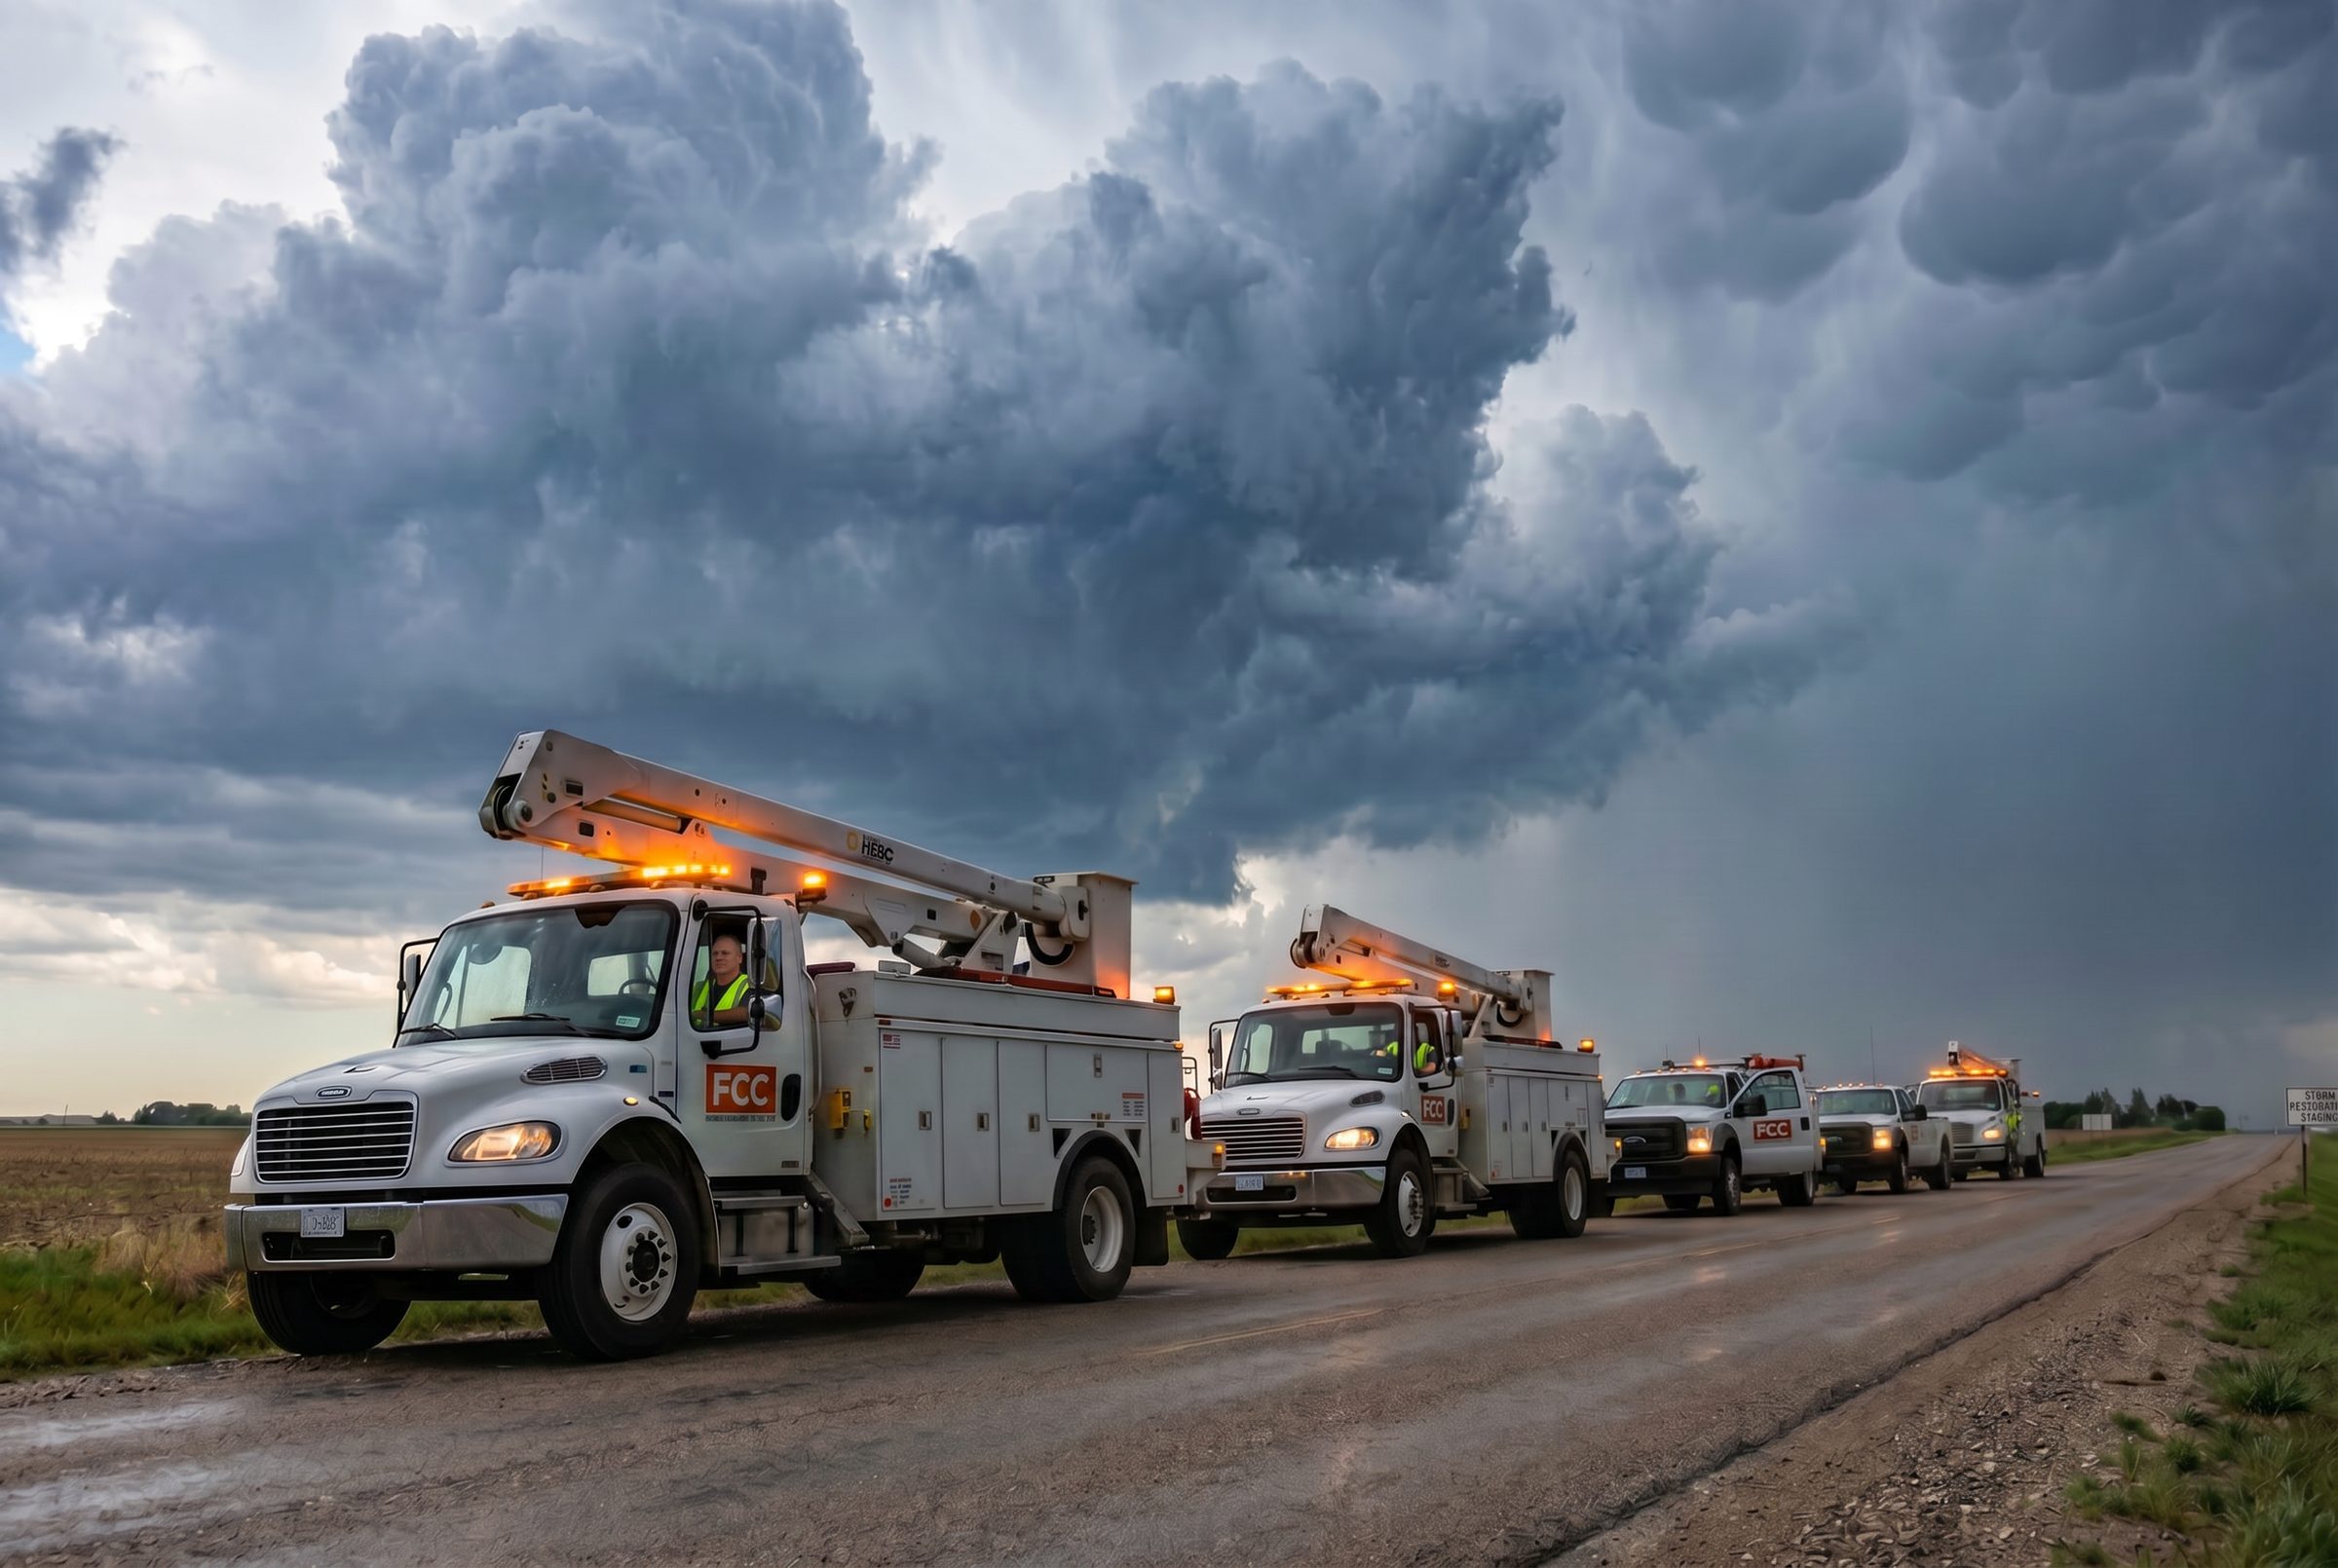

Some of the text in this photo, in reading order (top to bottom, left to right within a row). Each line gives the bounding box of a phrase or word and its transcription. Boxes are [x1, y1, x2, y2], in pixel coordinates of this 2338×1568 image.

[713, 1072, 770, 1106] FCC
[1423, 1100, 1443, 1118] FCC
[1756, 1122, 1789, 1138] FCC
